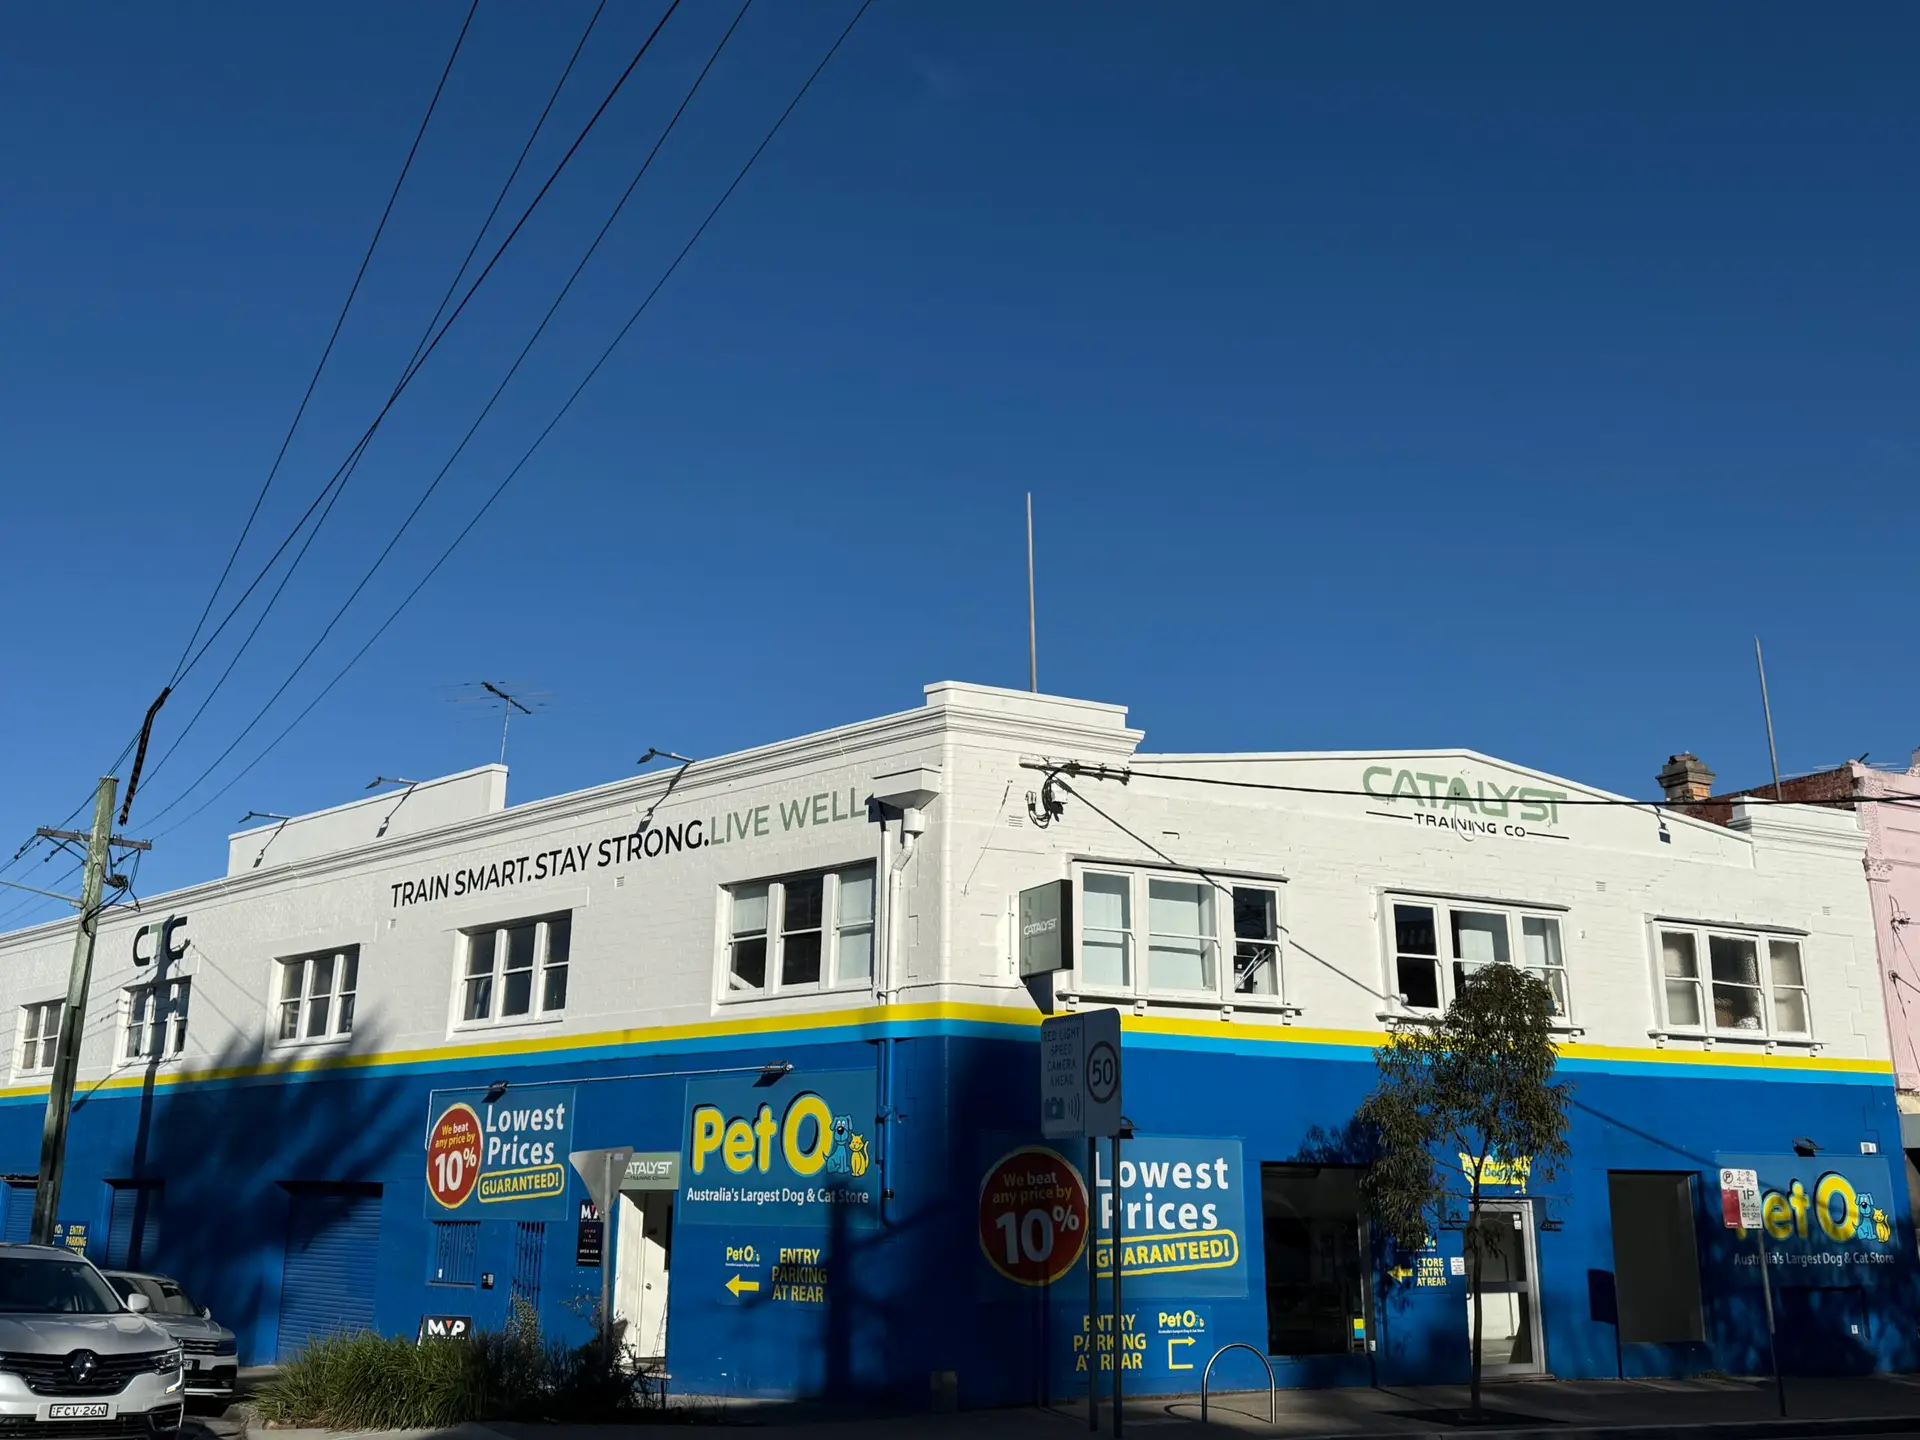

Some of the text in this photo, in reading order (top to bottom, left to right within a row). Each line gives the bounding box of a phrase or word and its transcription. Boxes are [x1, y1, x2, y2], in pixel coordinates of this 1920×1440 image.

[1362, 766, 1567, 824] CATALYST
[1414, 813, 1525, 837] TRAINING CO
[391, 878, 448, 908] TRAIN
[779, 787, 867, 830] WELL
[1024, 917, 1058, 936] CATALYST
[1060, 1027, 1080, 1040] LIGHT
[1051, 1044, 1072, 1057] SPEED
[1047, 1059, 1076, 1072] CAMERA
[1092, 1059, 1113, 1086] 50
[1051, 1074, 1074, 1087] AHEAD
[486, 1102, 565, 1133] Lowest
[442, 1122, 469, 1135] We beat
[435, 1131, 476, 1149] any price by
[487, 1135, 555, 1166] Prices
[435, 1146, 477, 1192] 10%
[624, 1161, 673, 1175] ATALYST
[1095, 1151, 1229, 1190] Lowest
[481, 1172, 559, 1195] GUARANTEED!
[1003, 1171, 1057, 1188] We beat
[687, 1187, 869, 1206] Australia's Largest Dog & Cat Store
[992, 1185, 1072, 1205] any price by
[1736, 1170, 1859, 1242] etO
[995, 1205, 1080, 1265] 10%
[780, 1248, 820, 1265] ENTRY
[1416, 1257, 1444, 1267] STORE
[1734, 1251, 1895, 1267] Austrlia's Largest Dog & Cat Store
[771, 1265, 828, 1283] PARKING
[1417, 1267, 1444, 1277] ENTRY
[1416, 1277, 1447, 1287] AT REAR
[772, 1284, 824, 1302] AT REAR
[1073, 1333, 1147, 1352] PRKNG
[1100, 1352, 1143, 1371] RAR
